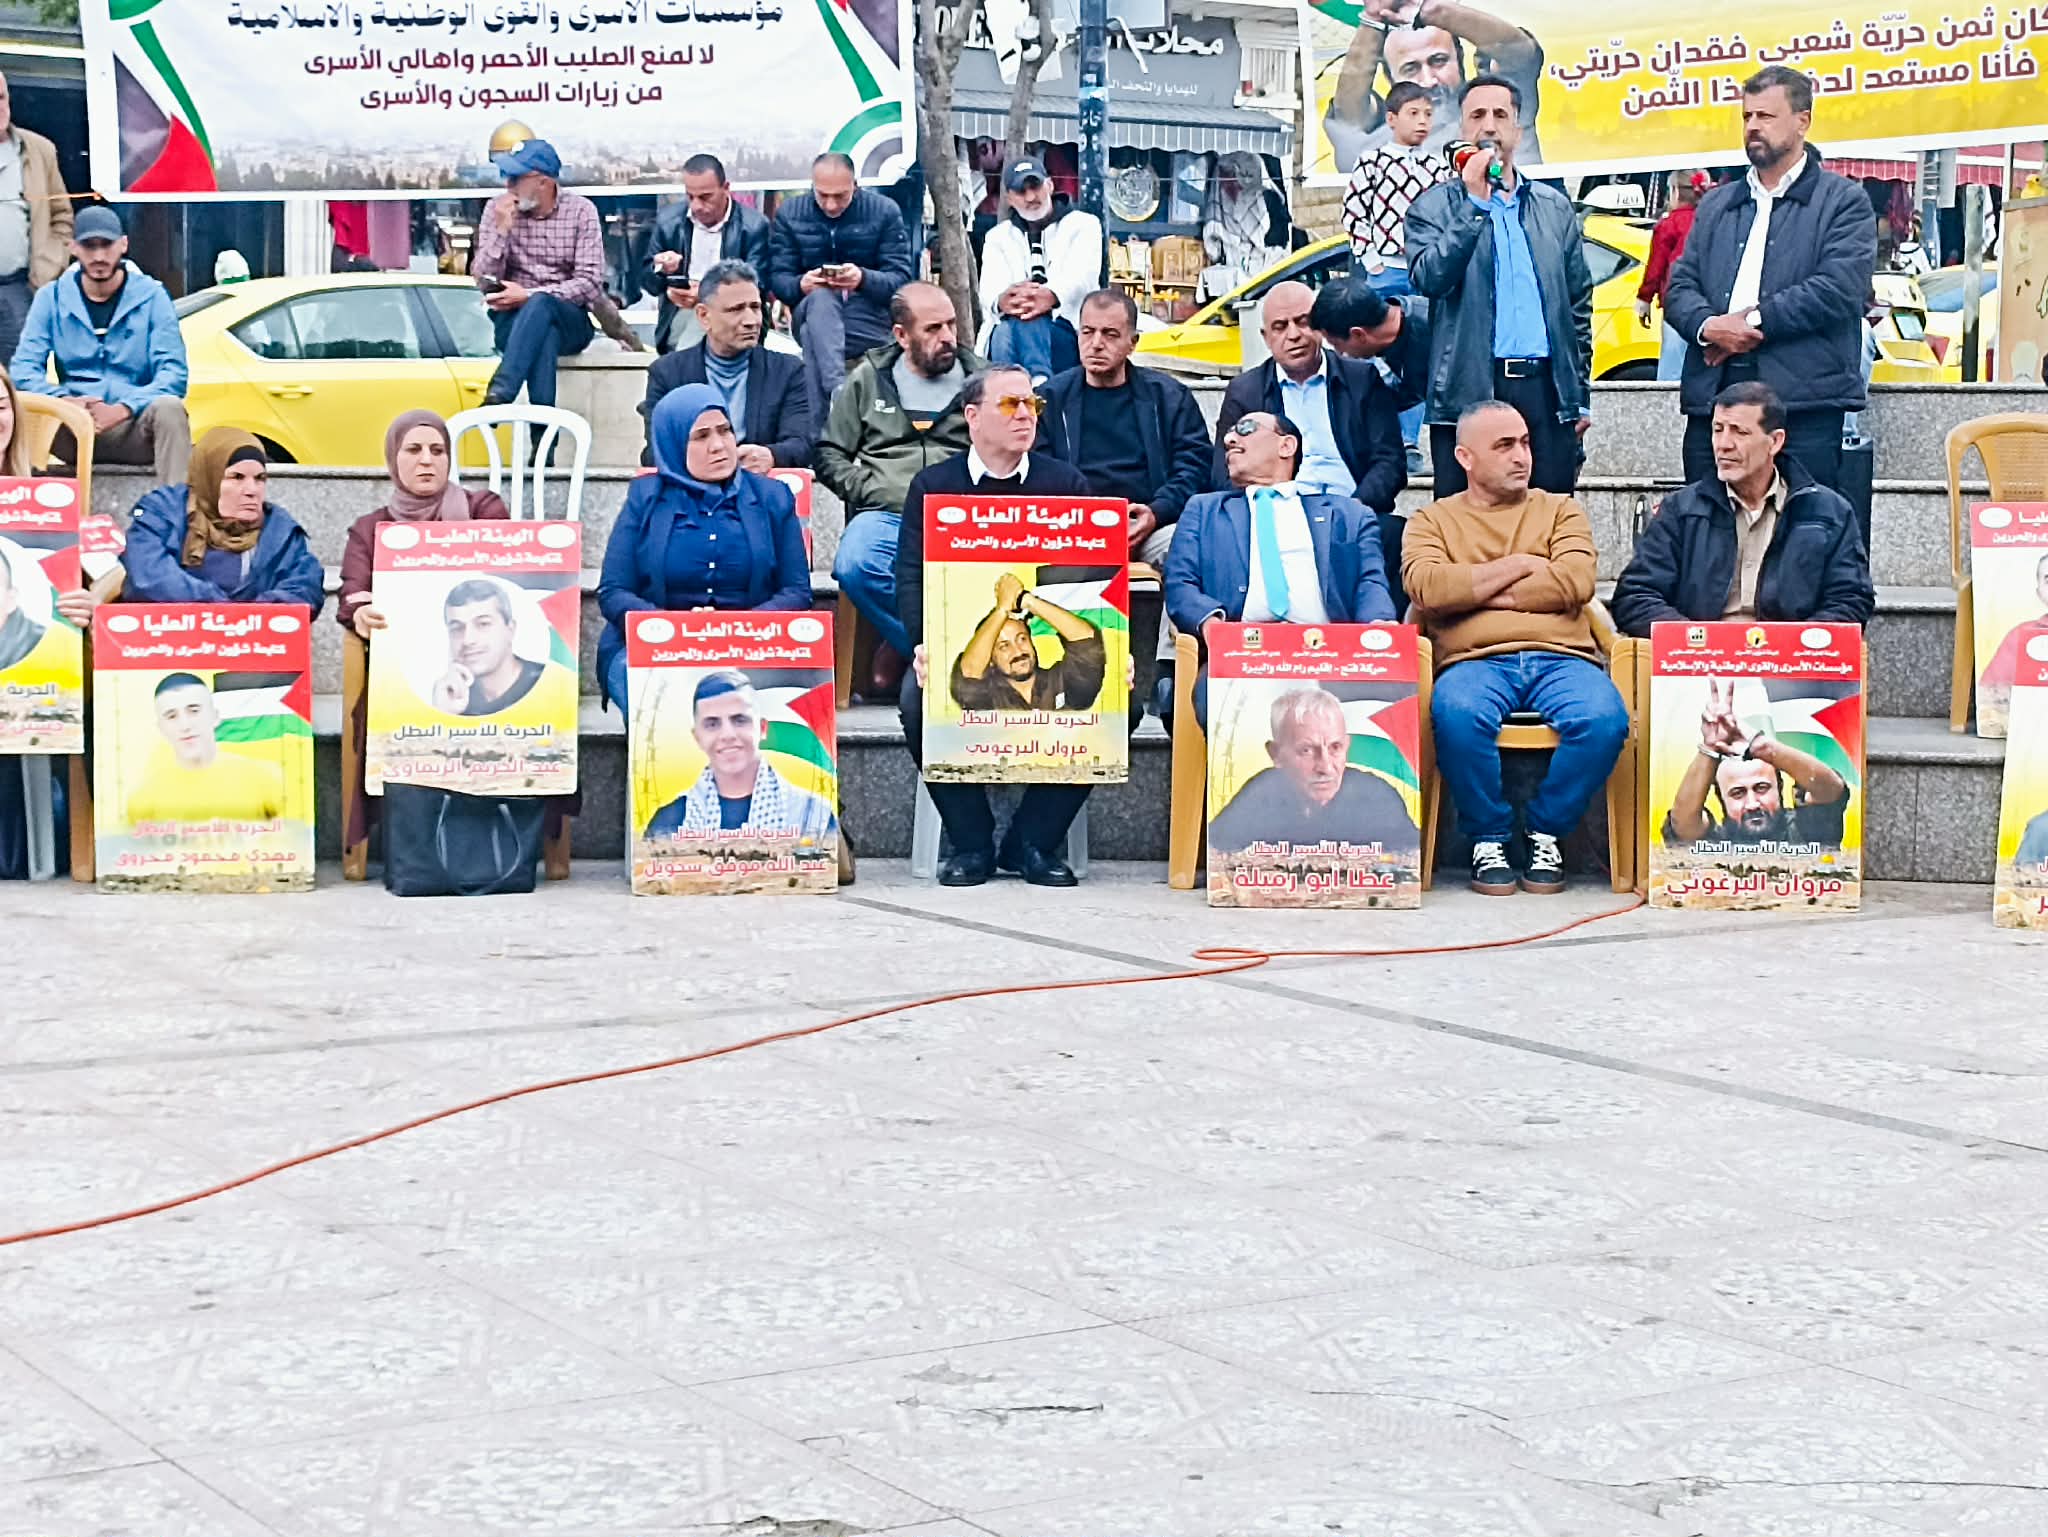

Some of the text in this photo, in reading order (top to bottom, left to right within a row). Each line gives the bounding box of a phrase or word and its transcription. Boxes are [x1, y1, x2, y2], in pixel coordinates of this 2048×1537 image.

[371, 0, 474, 34] الوطنية
[484, 0, 559, 34] والقوى
[656, 0, 783, 30] مؤسسات
[1936, 6, 1994, 46] ثمن
[304, 42, 714, 78] لا لمنع الصليب الأحمر واهالي الأسرى
[1651, 35, 1746, 72] فقدان
[1982, 44, 2035, 79] فأنا
[1712, 78, 1744, 102] ذا
[1809, 68, 1852, 94] لدف
[1864, 61, 1969, 89] مستعد
[360, 79, 662, 110] من زيارات السجون والأسرى
[971, 505, 1083, 529] الهيئة العليا
[425, 528, 534, 548] الهيئة العليا
[143, 612, 262, 637] الهيئة العليا
[682, 622, 782, 642] الهيئة العليا
[1235, 862, 1396, 893] عطا أبو رميلة
[1667, 868, 1843, 899] مروان البرغوثي
